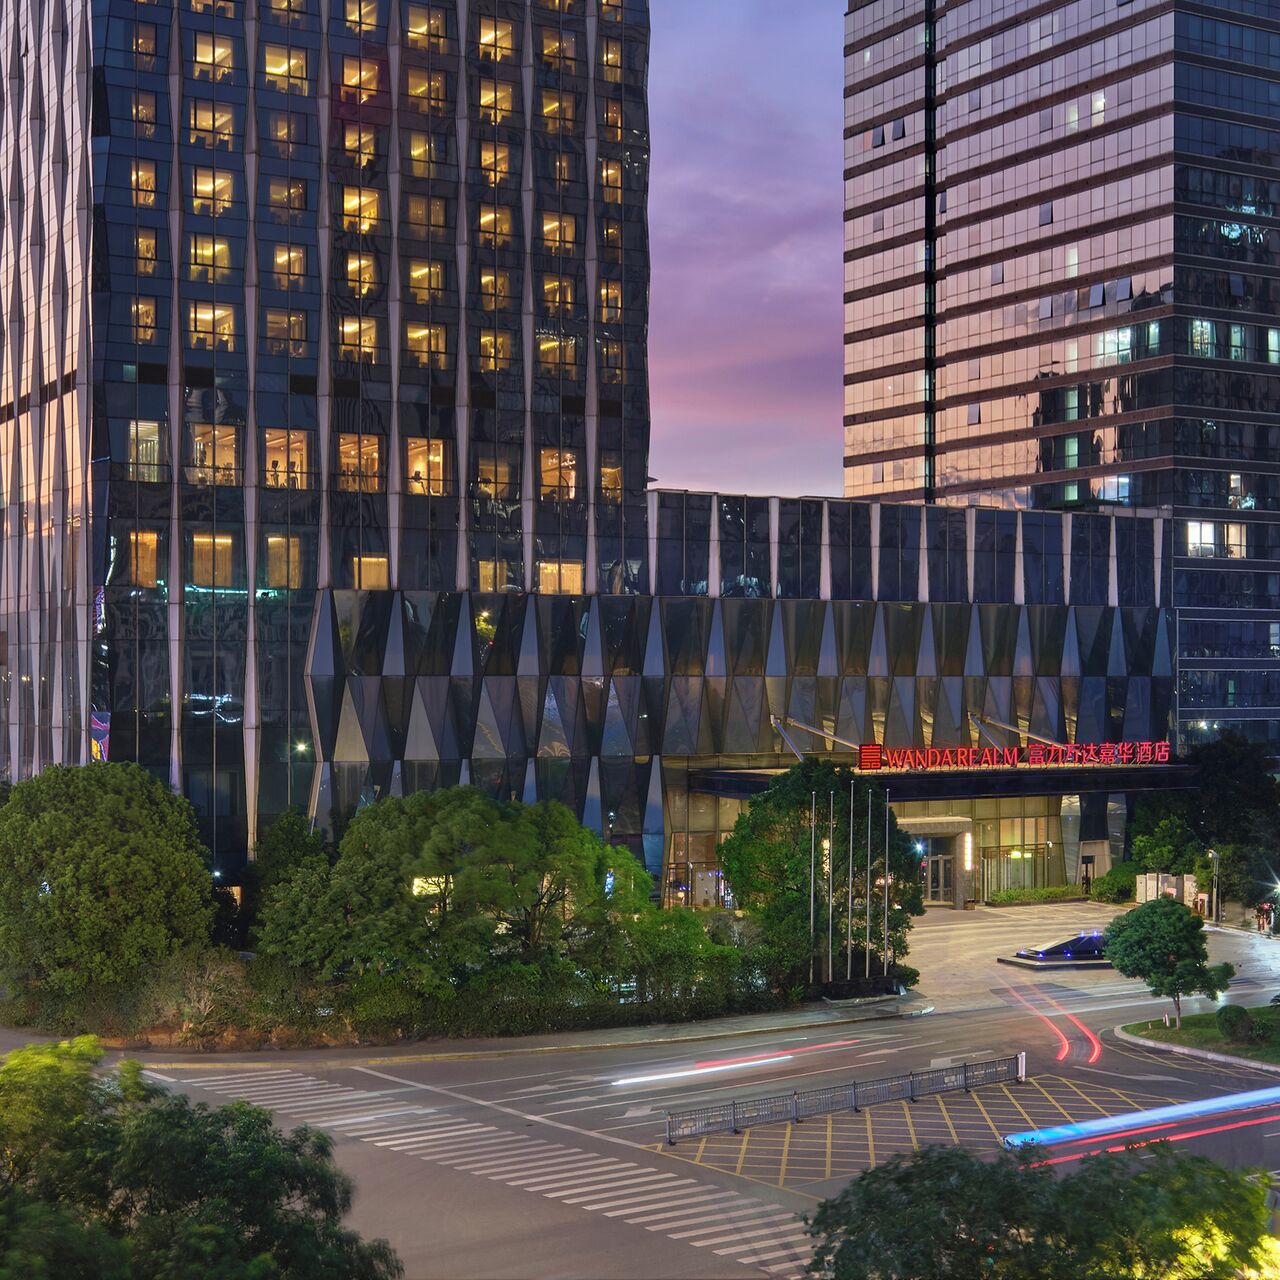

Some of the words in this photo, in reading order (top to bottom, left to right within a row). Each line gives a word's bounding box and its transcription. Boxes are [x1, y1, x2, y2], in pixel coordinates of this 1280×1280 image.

[886, 748, 952, 769] WANDA
[957, 746, 1019, 769] REALM
[1028, 741, 1171, 765] 富力万达嘉华酒店
